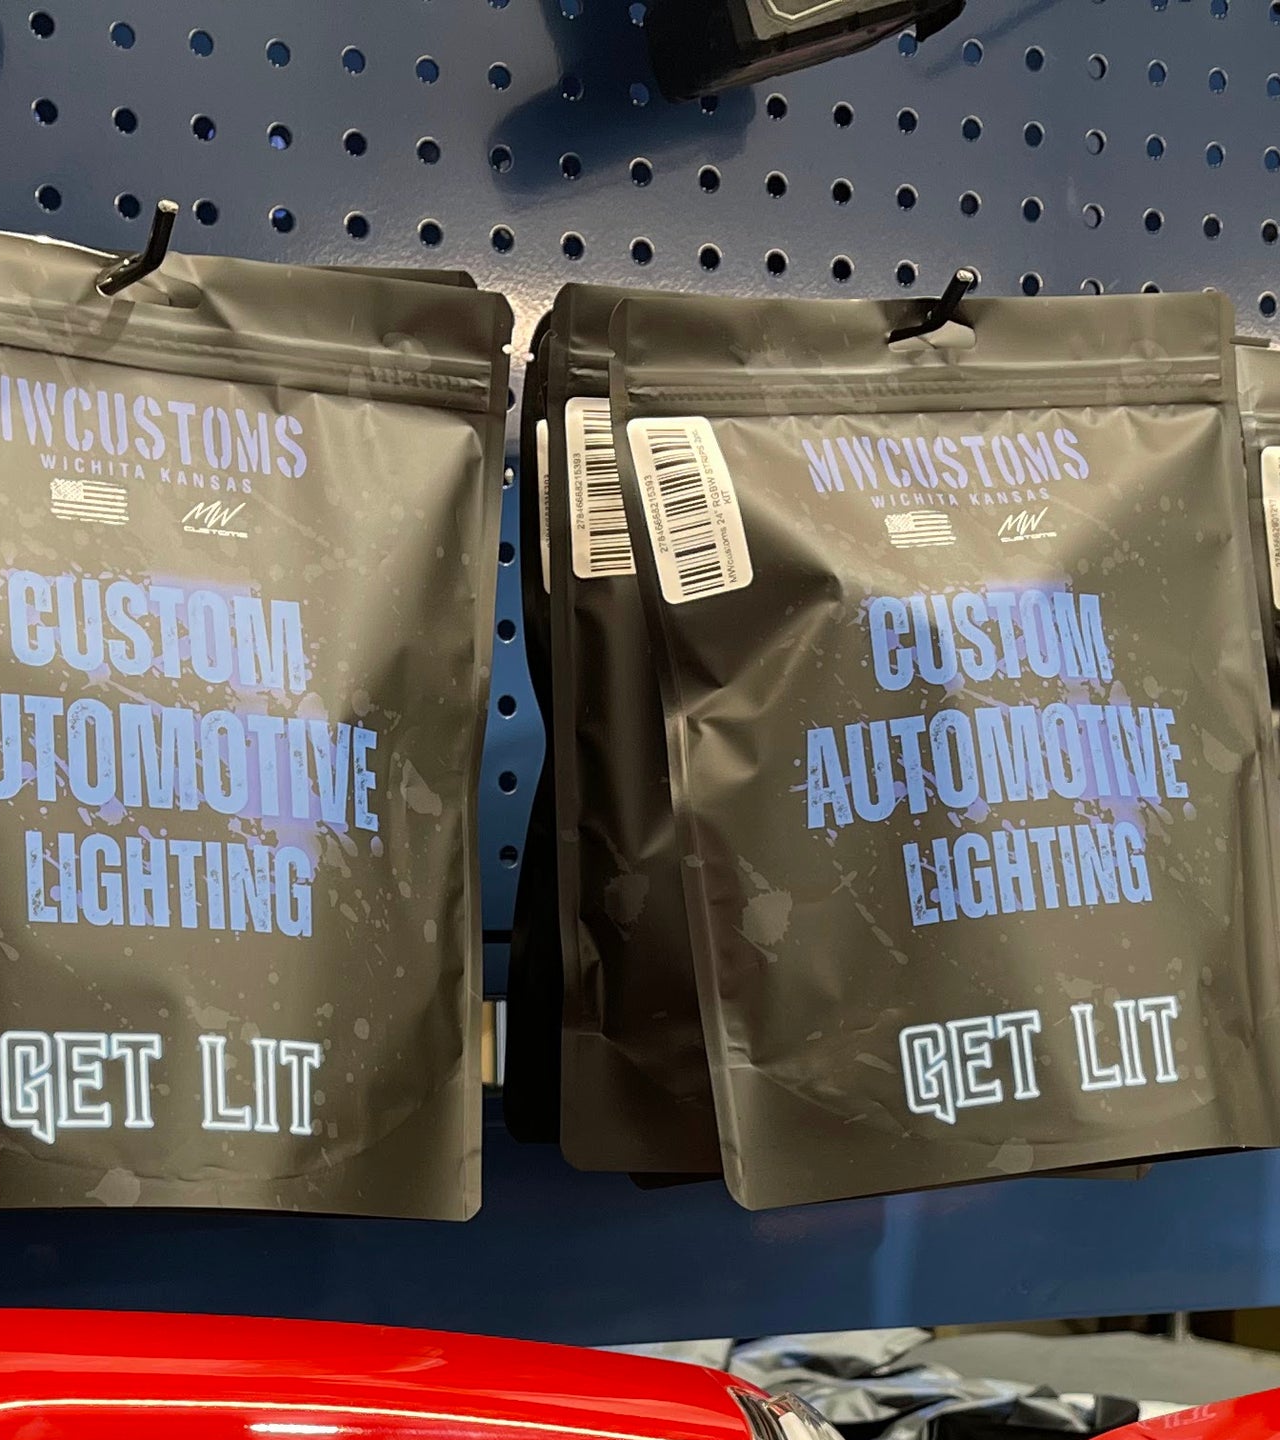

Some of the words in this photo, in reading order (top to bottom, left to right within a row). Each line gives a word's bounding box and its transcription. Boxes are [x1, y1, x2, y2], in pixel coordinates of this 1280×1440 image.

[41, 453, 145, 480] WICHITA
[161, 467, 253, 494] KANSAS
[697, 442, 712, 478] STRIPS
[801, 428, 1089, 493] MWCUSTOMS
[181, 500, 247, 529] MW
[707, 478, 722, 508] RGBW
[721, 490, 732, 505] KIT
[870, 493, 958, 509] WICHITA
[969, 487, 1050, 507] KANSAS
[997, 506, 1048, 536] MW
[7, 569, 307, 694] CUSTOM
[868, 589, 1113, 691] CUSTOM
[806, 703, 1189, 829] AUTOMOTIVE
[25, 830, 313, 938] LIGHTING
[902, 821, 1152, 927] LIGHTING
[0, 1030, 162, 1144] GET
[198, 1034, 321, 1136] LIT
[899, 1009, 1041, 1124] GET
[1070, 995, 1178, 1091] LIT
